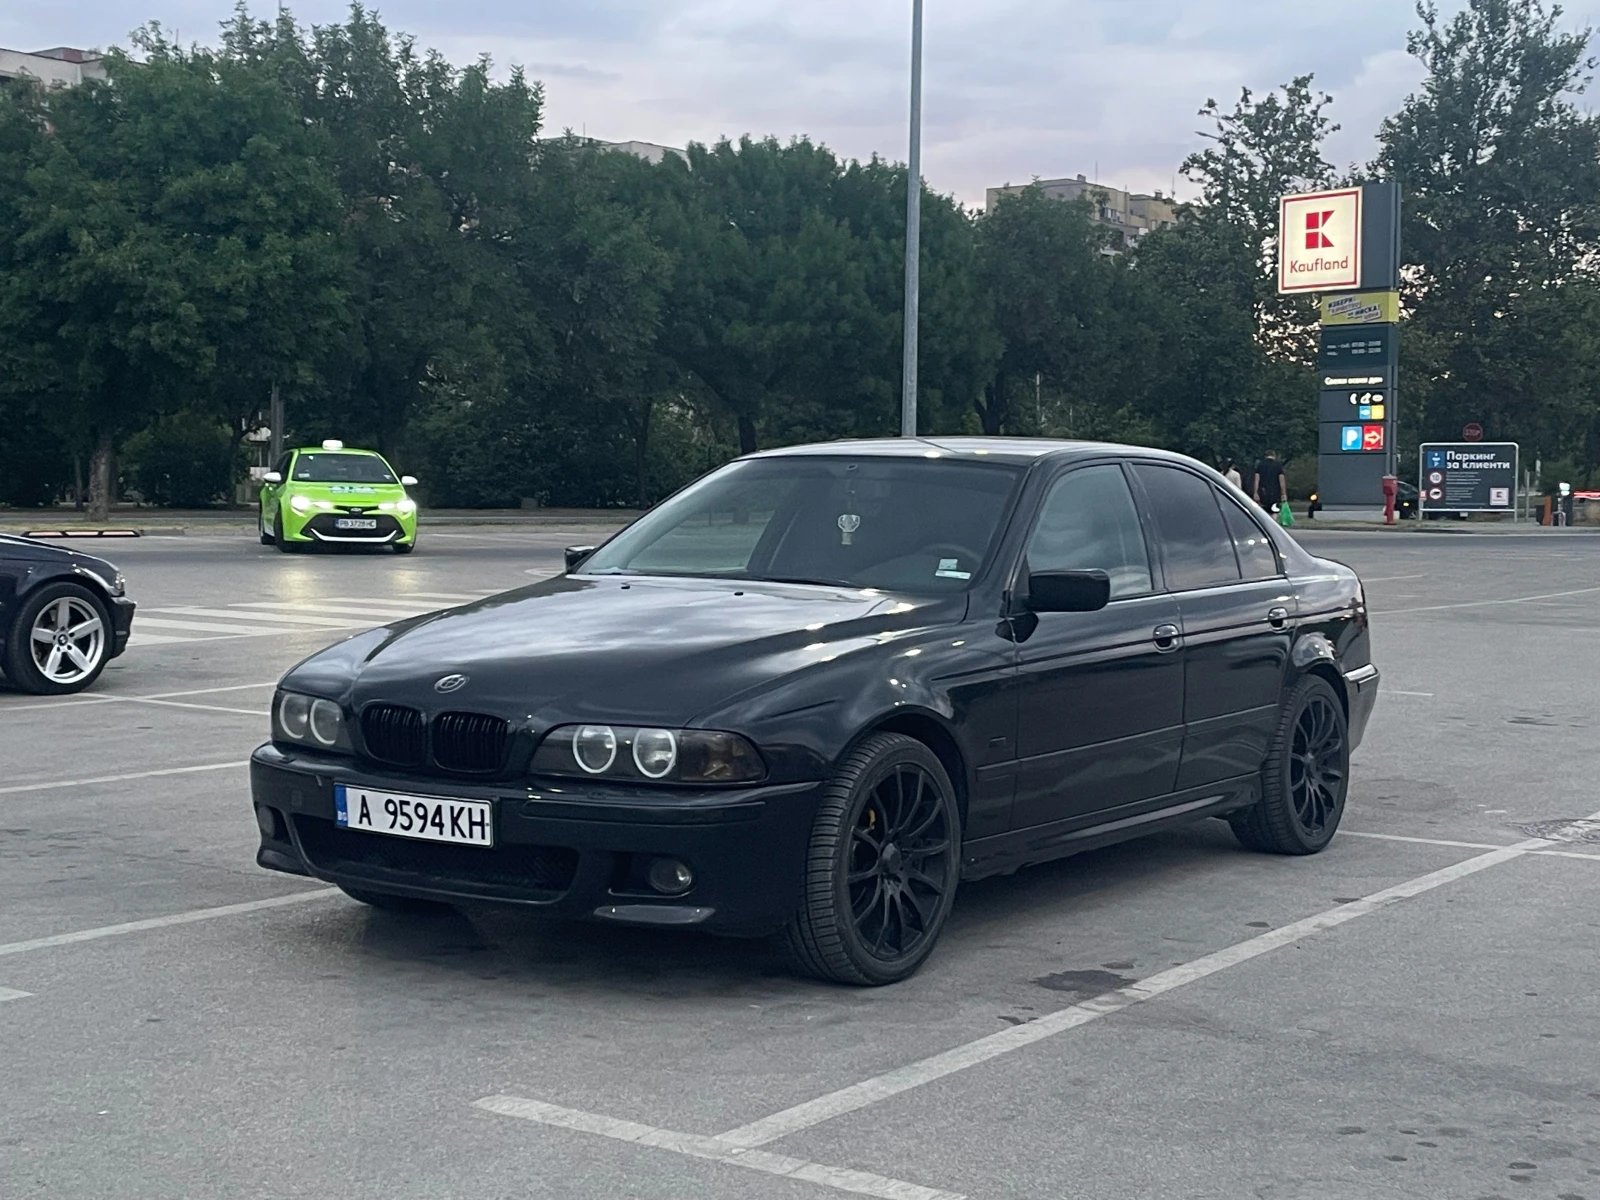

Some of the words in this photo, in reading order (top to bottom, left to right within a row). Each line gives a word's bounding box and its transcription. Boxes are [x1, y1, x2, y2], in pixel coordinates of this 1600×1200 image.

[1290, 256, 1348, 274] Kaufland
[1346, 429, 1358, 447] P
[1446, 451, 1495, 462] Паркинг
[1446, 461, 1460, 469] за
[1462, 461, 1510, 469] клиенти
[358, 794, 372, 826] A
